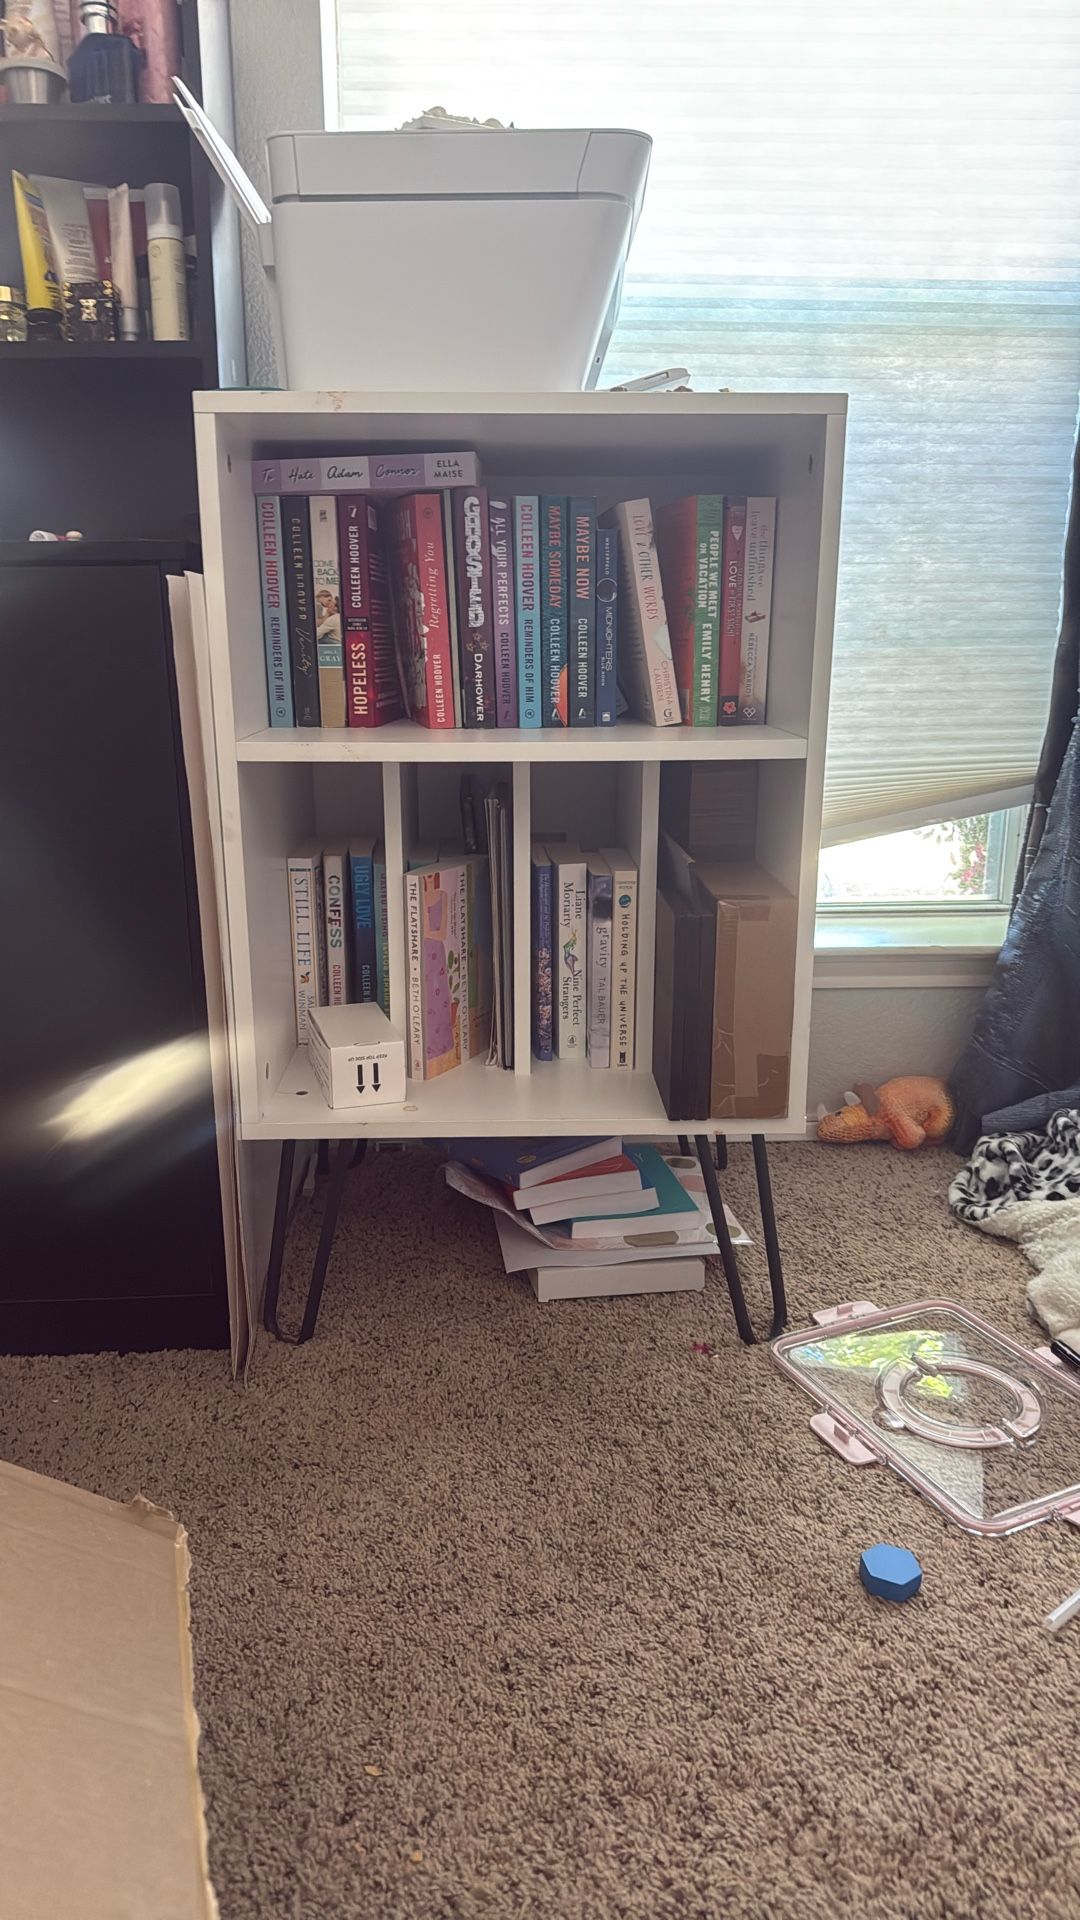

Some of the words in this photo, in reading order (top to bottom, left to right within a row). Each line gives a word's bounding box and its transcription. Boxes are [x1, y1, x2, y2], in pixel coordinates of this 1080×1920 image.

[288, 466, 315, 483] Hate
[327, 466, 363, 479] Adam
[375, 463, 419, 477] Connor
[434, 470, 463, 478] MAISE
[437, 460, 460, 468] ELLA
[262, 502, 278, 556] COLLEEN
[292, 518, 303, 568] COLLEEN
[496, 517, 506, 536] ALL
[521, 504, 534, 558] COLLEEN
[548, 506, 560, 546] MAYBE
[576, 516, 590, 562] MAYBE
[633, 515, 644, 536] LOVE
[348, 526, 360, 564] HOOVER
[425, 542, 435, 562] You
[496, 540, 507, 568] YOUR
[709, 530, 720, 570] PEOPLE
[266, 560, 280, 608] HOOVER
[548, 552, 561, 608] SOMEDAY
[576, 568, 590, 600] NOW
[640, 552, 653, 582] OTHER
[698, 557, 708, 608] VACATION
[708, 572, 718, 588] WE
[728, 560, 738, 588] LOVE
[747, 542, 758, 600] unfinished
[296, 574, 306, 620] HOOVER
[350, 566, 362, 608] COLLEEN
[426, 568, 440, 628] Regretting
[498, 572, 509, 624] PERFECTS
[522, 563, 534, 611] HOOVER
[644, 586, 659, 620] WORDS
[708, 590, 718, 618] MEET
[270, 617, 282, 668] REMINDERS
[500, 632, 510, 669] COLLEEN
[524, 620, 534, 670] REMINDERS
[550, 619, 560, 664] COLLEEN
[578, 618, 588, 658] COLLEEN
[701, 623, 712, 659] EMILY
[274, 670, 284, 682] OF
[351, 643, 368, 715] HOPELESS
[432, 654, 442, 686] HOOVER
[474, 654, 484, 720] DARHOWER
[502, 672, 510, 704] HOOVER
[525, 672, 534, 683] OF
[550, 666, 560, 704] HOOVER
[578, 662, 588, 698] HOOVER
[662, 660, 672, 705] CHRISTINA
[700, 664, 711, 702] HENRY
[275, 685, 284, 701] HIM
[435, 688, 446, 722] COLLEEN
[525, 687, 534, 702] HIM
[354, 865, 370, 894] UGLY
[294, 878, 309, 924] STILL
[328, 874, 342, 948] CONFESS
[356, 902, 371, 928] LOVE
[560, 882, 574, 928] Moriarty
[576, 890, 585, 919] Liane
[297, 932, 311, 966] LIFE
[410, 906, 418, 960] FLATSHARE
[596, 927, 610, 968] gravity
[621, 914, 630, 956] HOLDING
[333, 964, 341, 994] COLLEEN
[362, 964, 370, 996] COLLEEN
[573, 970, 582, 992] Nine
[620, 979, 628, 994] THE
[560, 976, 571, 1020] Strangers
[573, 994, 582, 1026] Perfect
[598, 996, 608, 1024] BAUER
[618, 1001, 628, 1046] UNIVERSE
